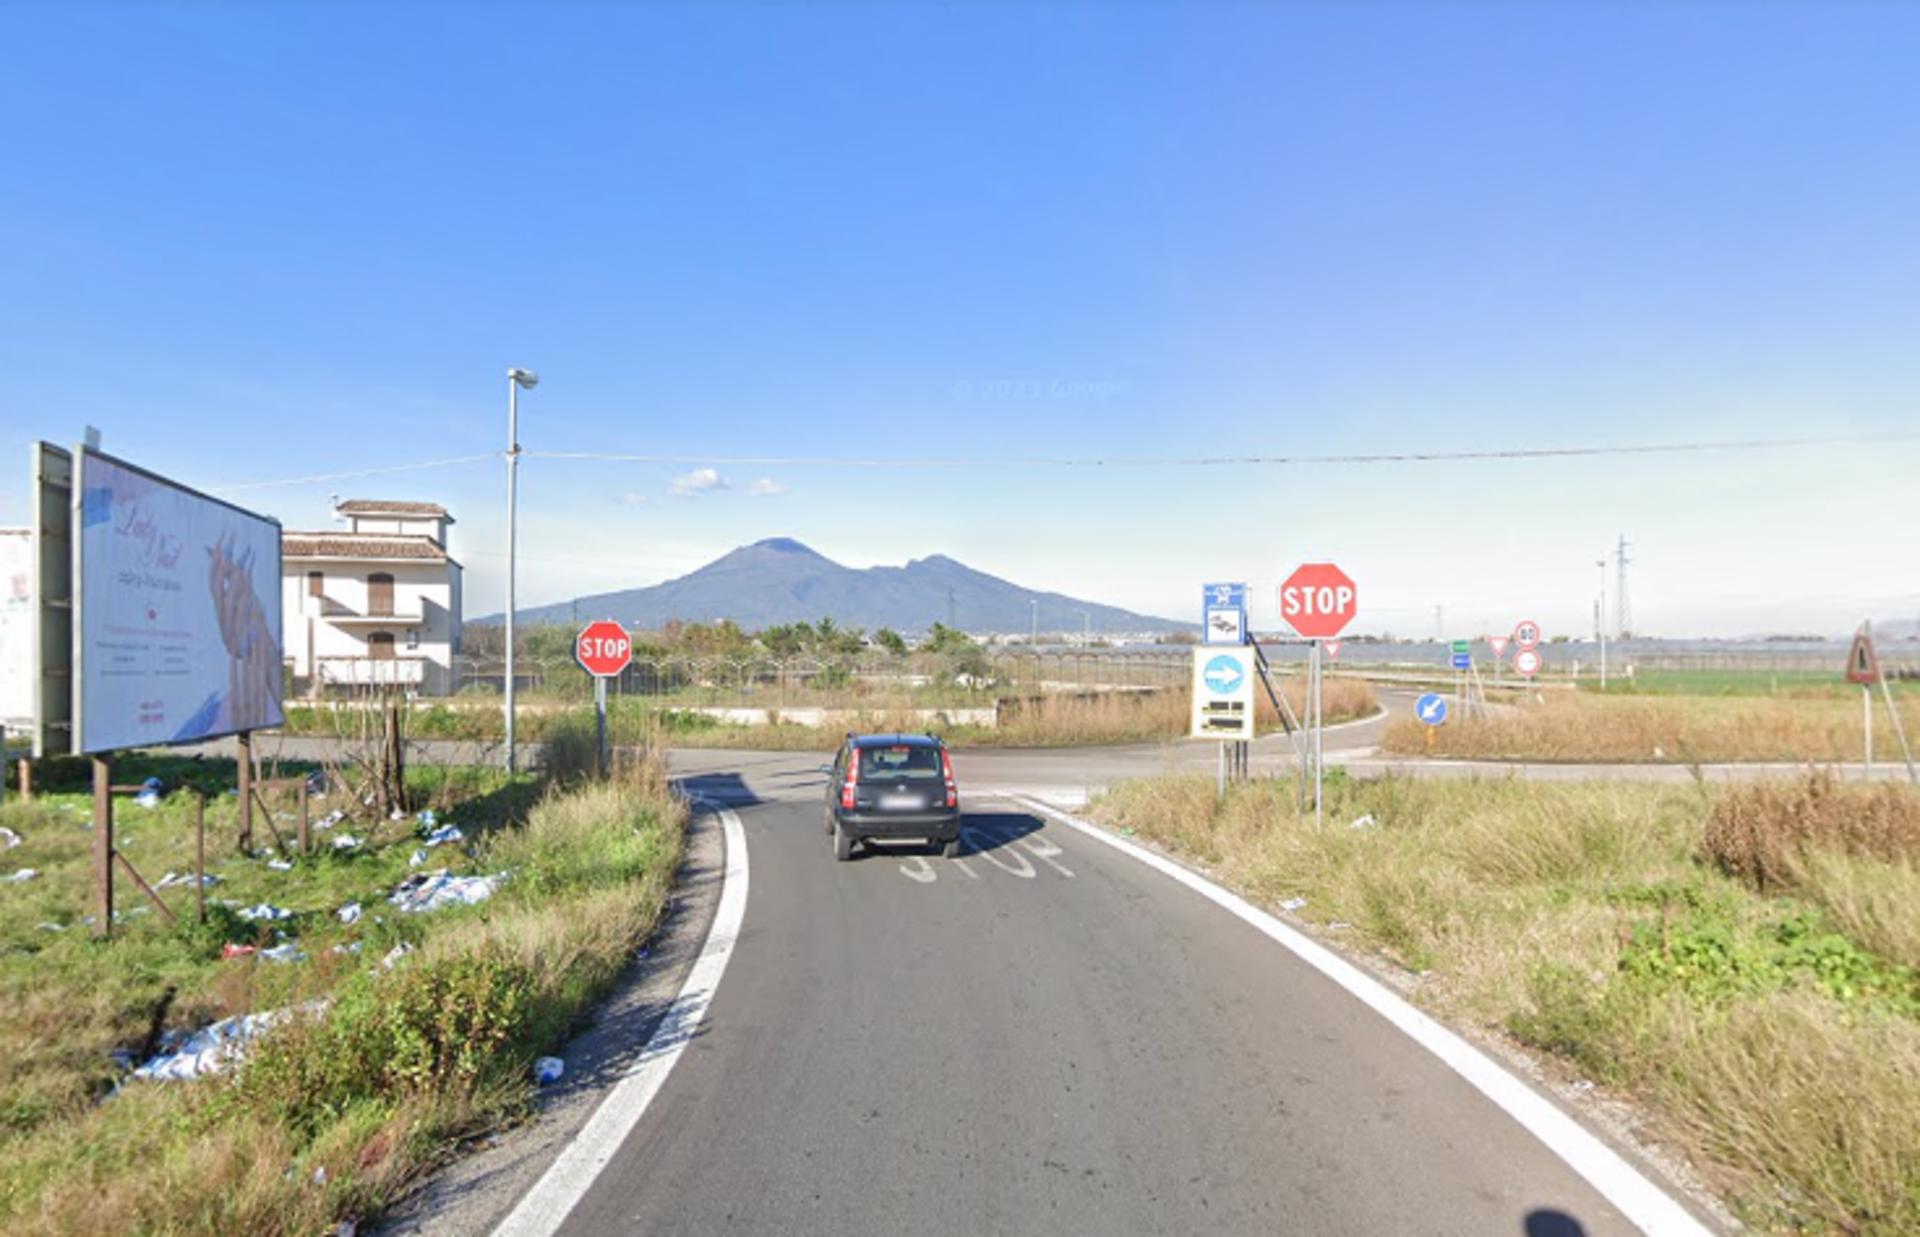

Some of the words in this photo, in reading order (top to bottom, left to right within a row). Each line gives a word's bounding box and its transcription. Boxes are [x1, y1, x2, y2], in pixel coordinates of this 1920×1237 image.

[1284, 586, 1353, 615] STOP
[580, 638, 628, 658] STOP
[900, 826, 1076, 883] SOP
